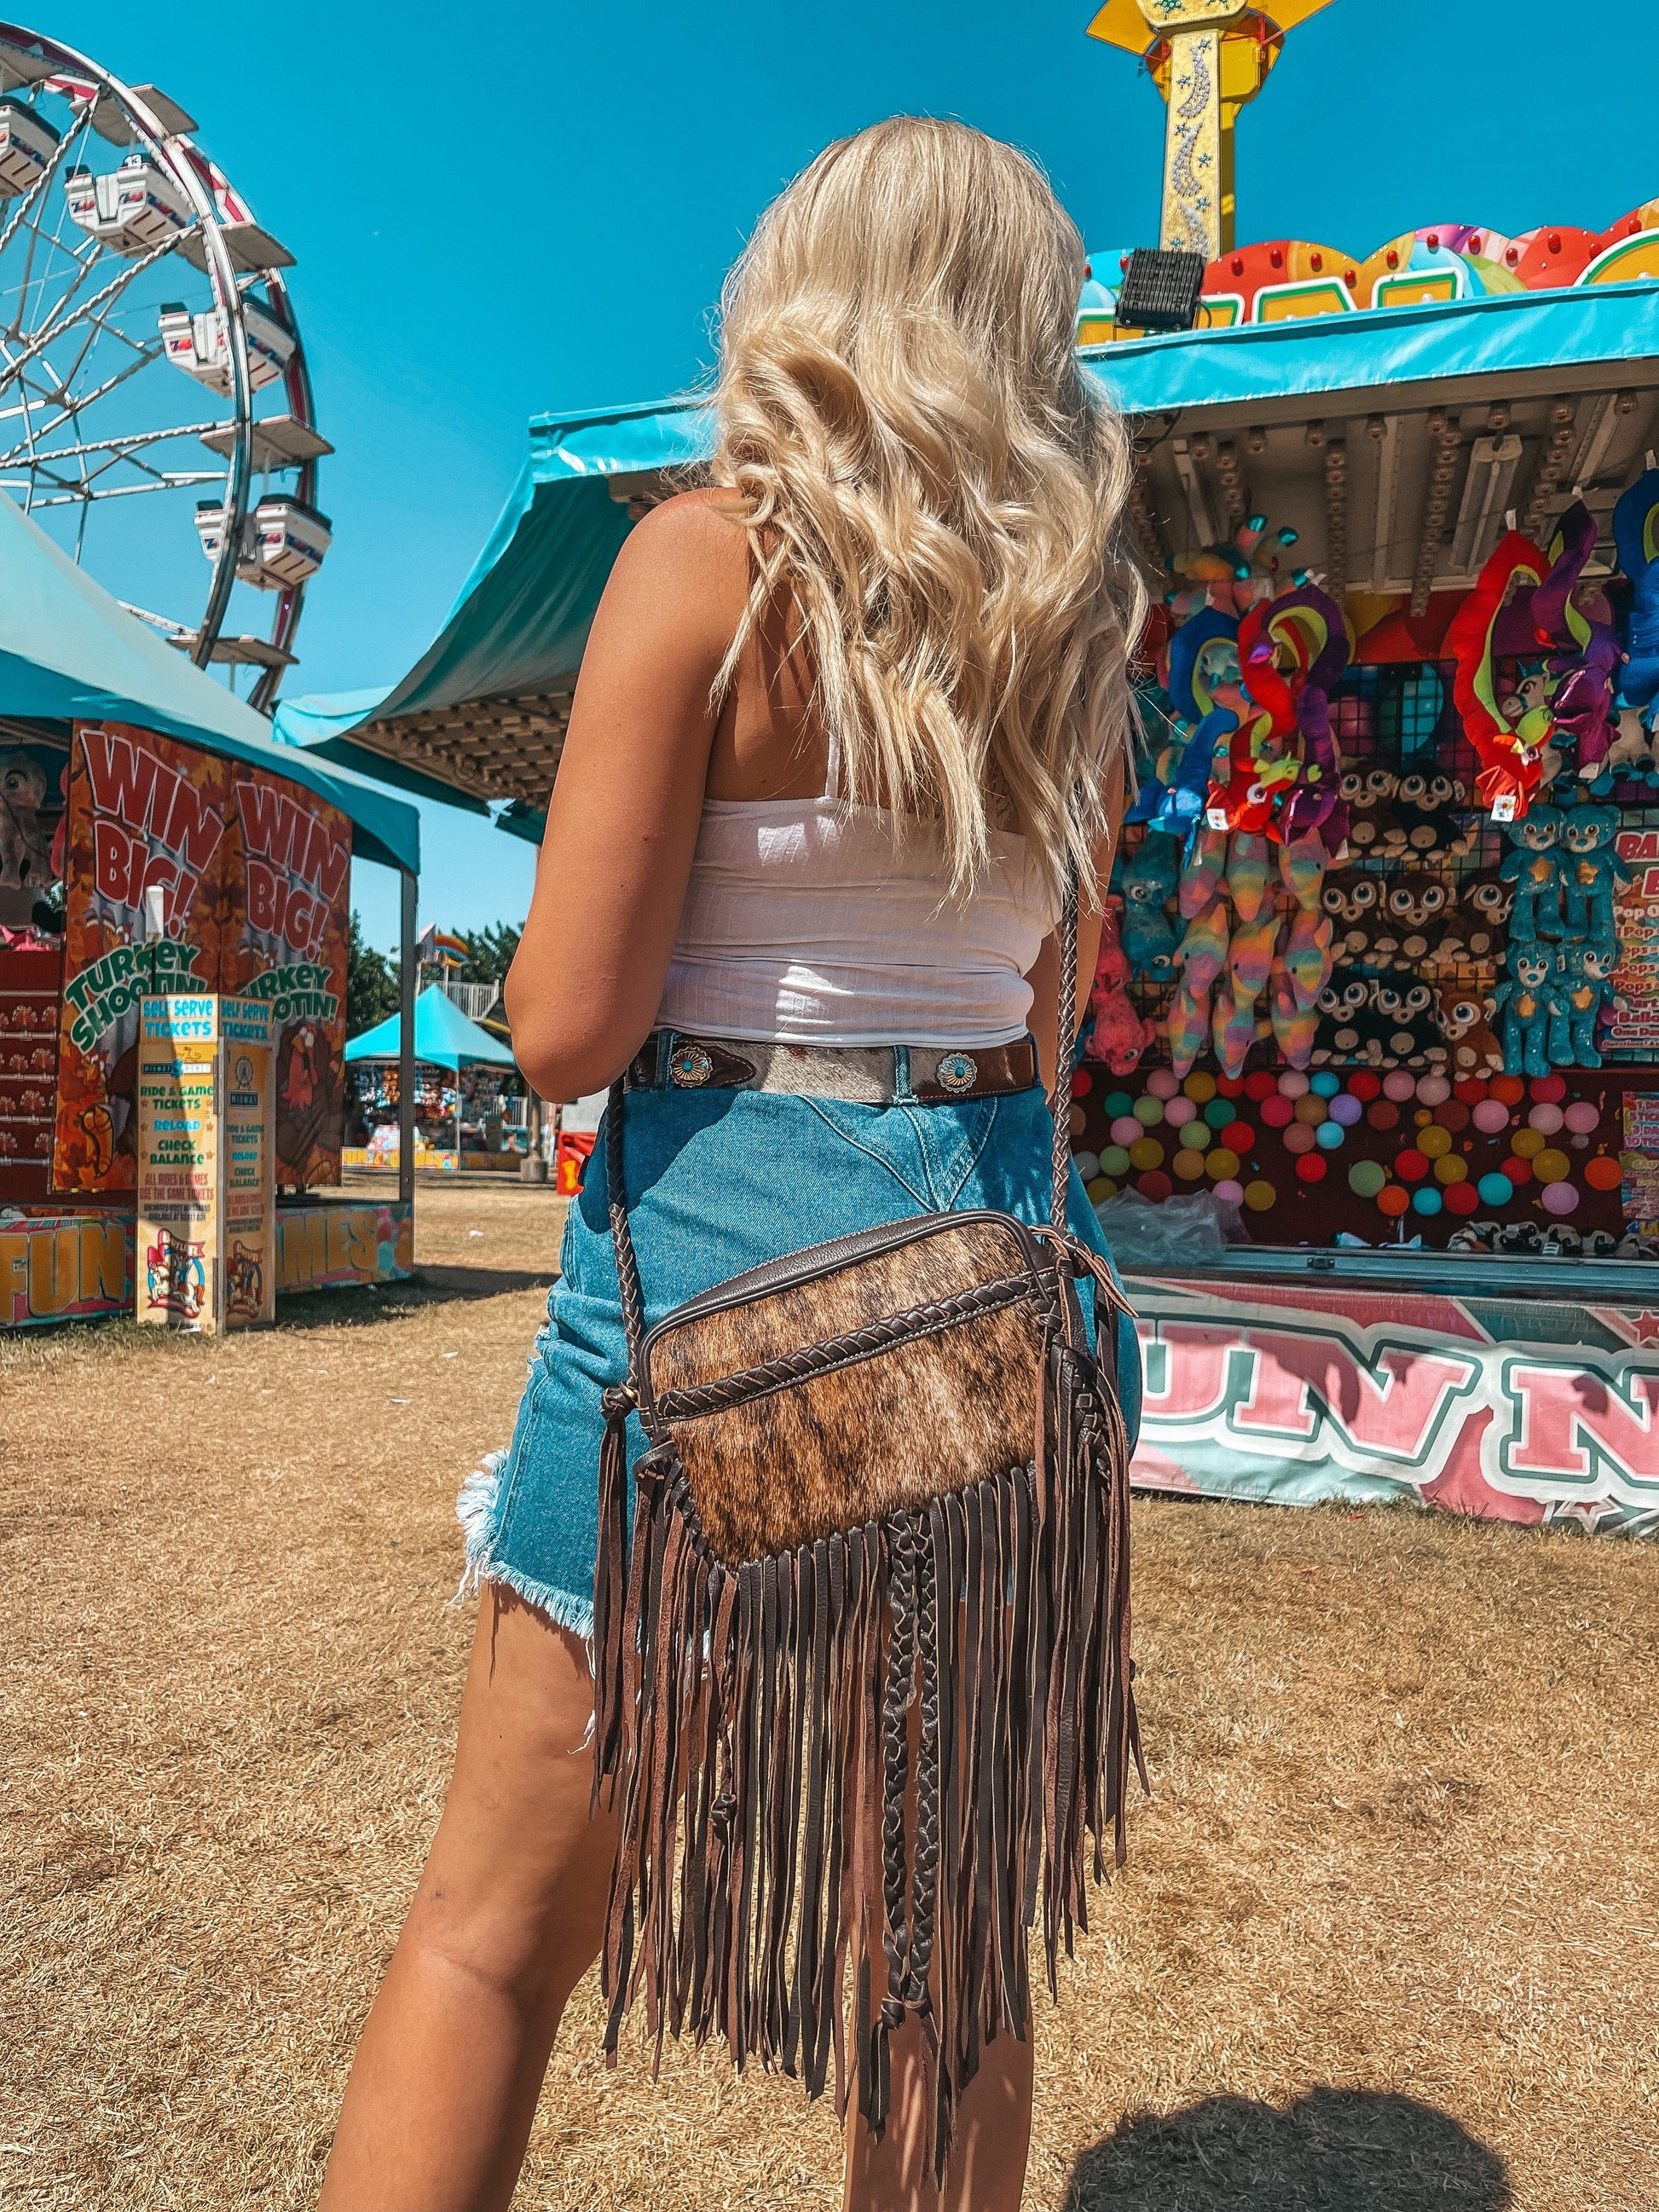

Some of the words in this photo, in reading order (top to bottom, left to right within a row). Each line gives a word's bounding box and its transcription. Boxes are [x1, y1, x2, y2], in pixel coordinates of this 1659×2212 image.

[80, 730, 225, 874] WIN
[237, 782, 350, 902] WIN
[95, 820, 198, 938] BIG!
[247, 860, 329, 962] BIG!
[174, 999, 213, 1017] SERVE
[143, 1020, 212, 1037] TICKETS
[222, 1022, 269, 1040] TICKETS
[141, 1085, 166, 1097] RIDE
[179, 1085, 215, 1096] GAME
[153, 1098, 201, 1111] TICKETS
[153, 1119, 201, 1132] RELOAD
[158, 1139, 196, 1152] CHECK
[149, 1153, 205, 1165] BALANCE
[0, 1223, 126, 1327] FUN
[275, 1208, 379, 1291] MES
